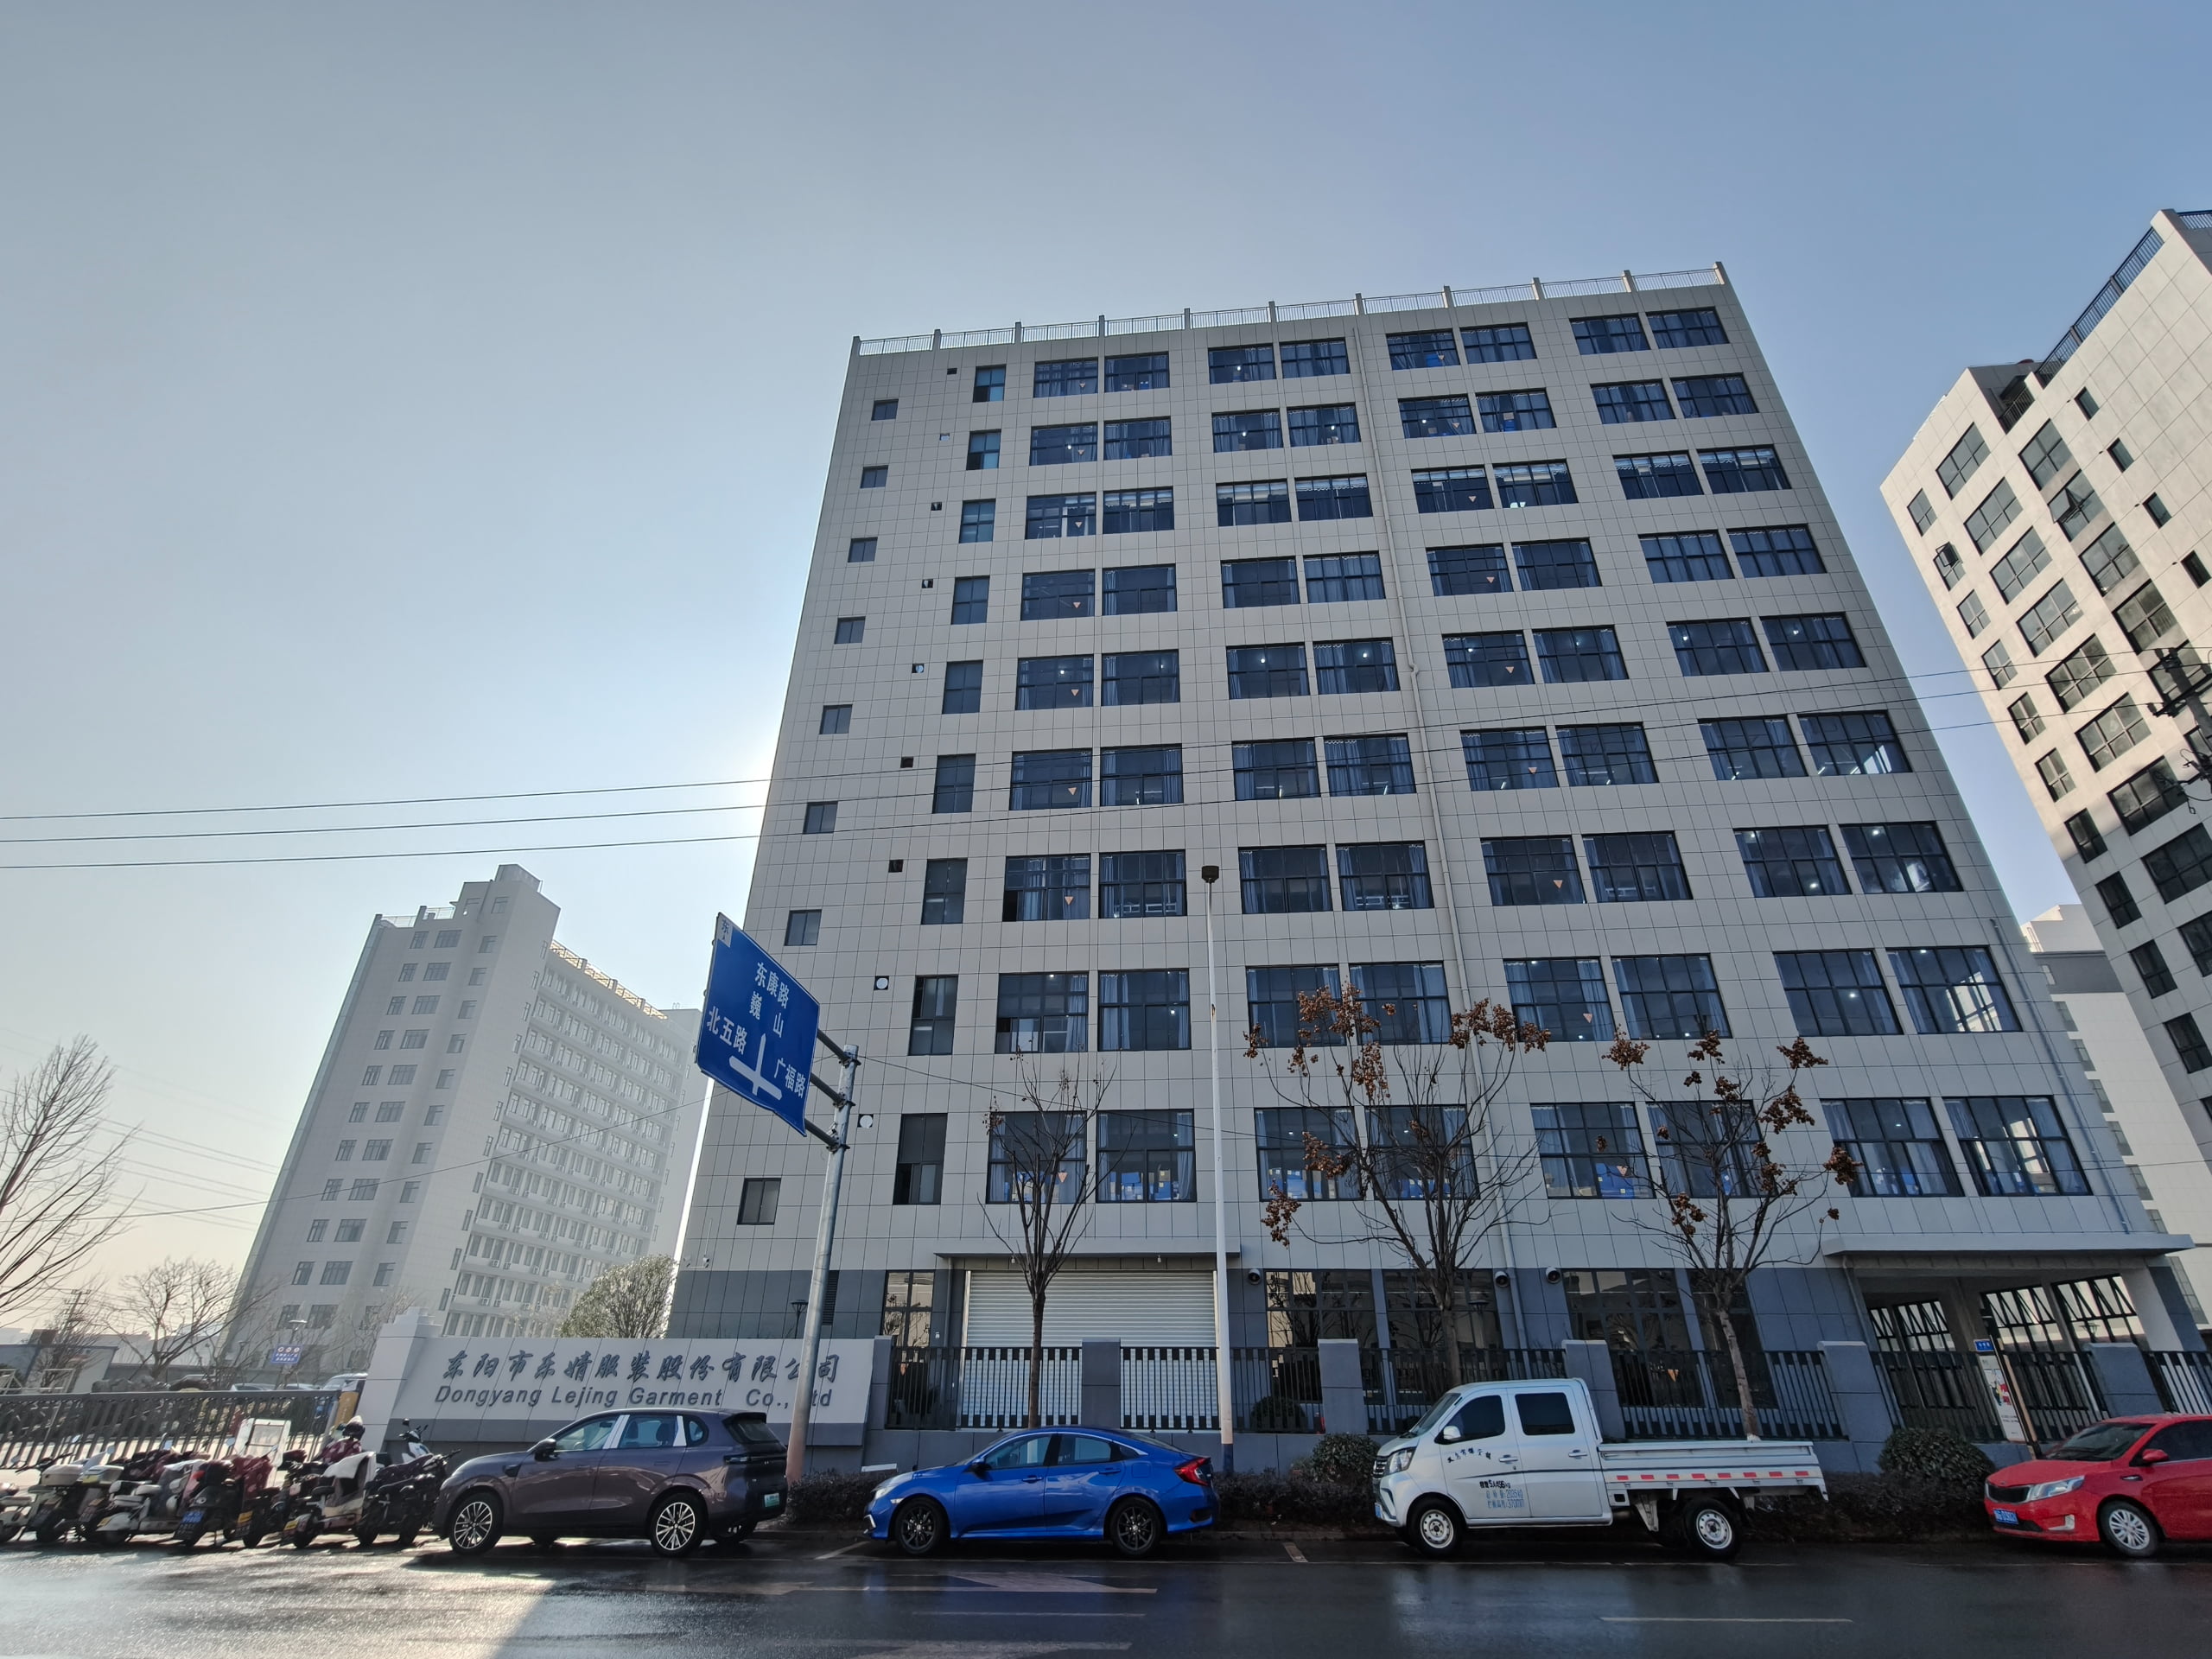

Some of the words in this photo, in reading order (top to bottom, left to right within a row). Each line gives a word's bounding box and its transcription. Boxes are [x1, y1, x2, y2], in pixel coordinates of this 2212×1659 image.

[754, 962, 790, 1009] 东康路
[707, 1006, 747, 1054] 北五路
[749, 991, 784, 1038] 巍山
[774, 1058, 806, 1098] 广福路
[435, 1385, 542, 1408] Dongyang
[551, 1386, 619, 1408] Lejing
[630, 1386, 722, 1406] Garment
[746, 1389, 789, 1409] Co.,
